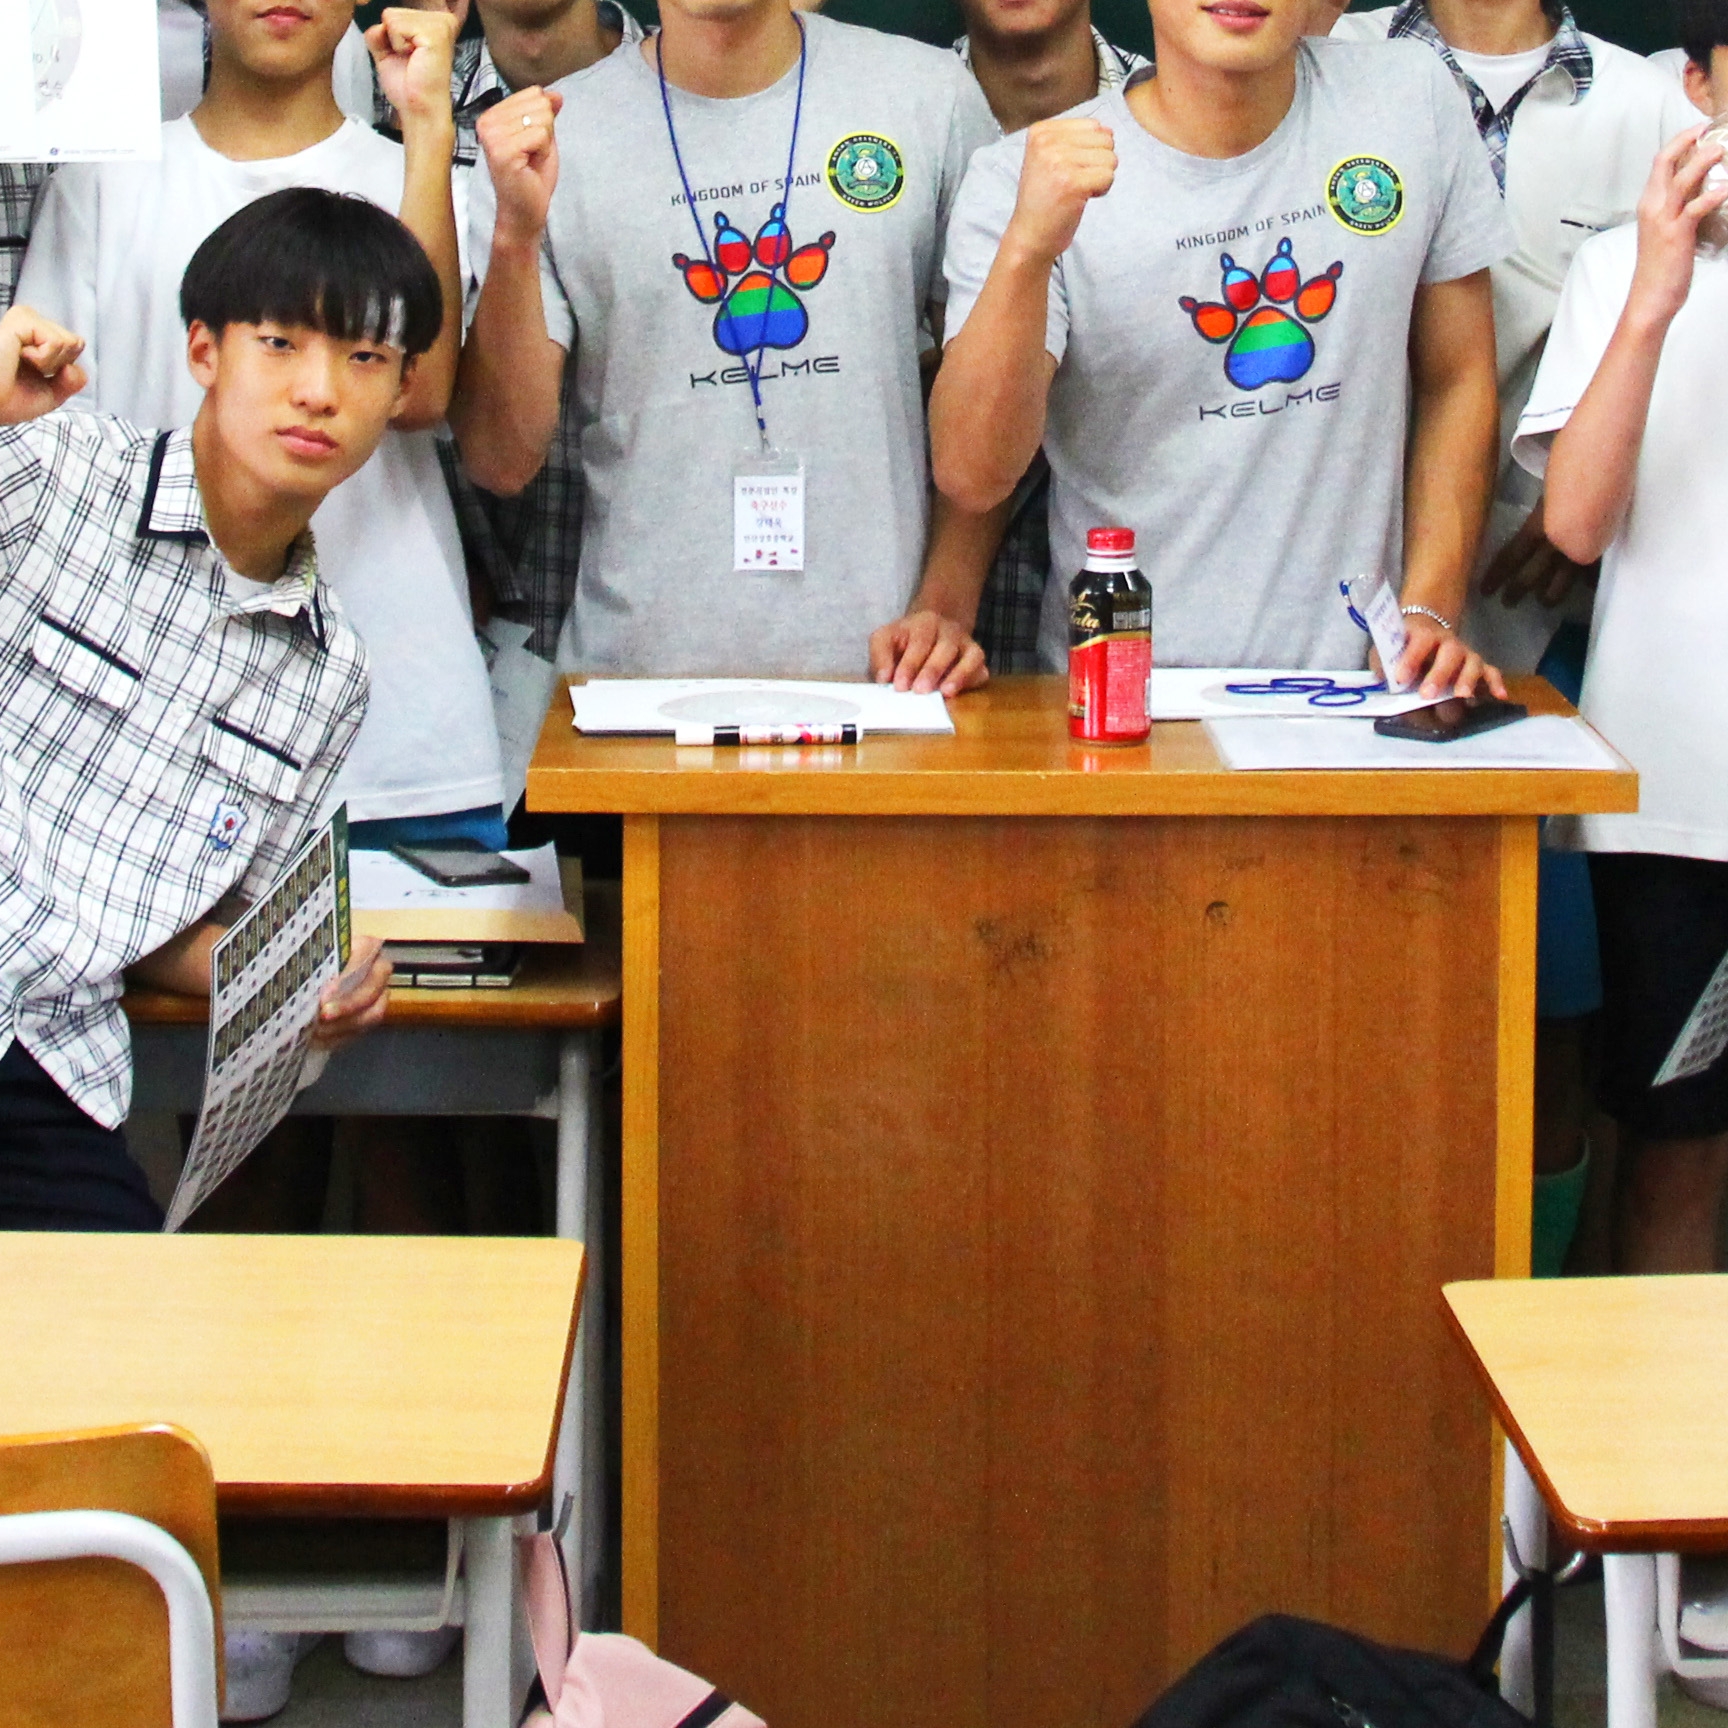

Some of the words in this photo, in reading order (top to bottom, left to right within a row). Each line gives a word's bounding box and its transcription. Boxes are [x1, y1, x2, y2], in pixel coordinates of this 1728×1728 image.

[671, 184, 744, 206] KINGDOM
[750, 180, 770, 194] OF
[1176, 225, 1250, 251] KINGDOM
[1256, 216, 1275, 233] OF
[1281, 204, 1326, 226] SPAIN
[690, 356, 840, 389] KELME
[1199, 382, 1341, 421] KELME
